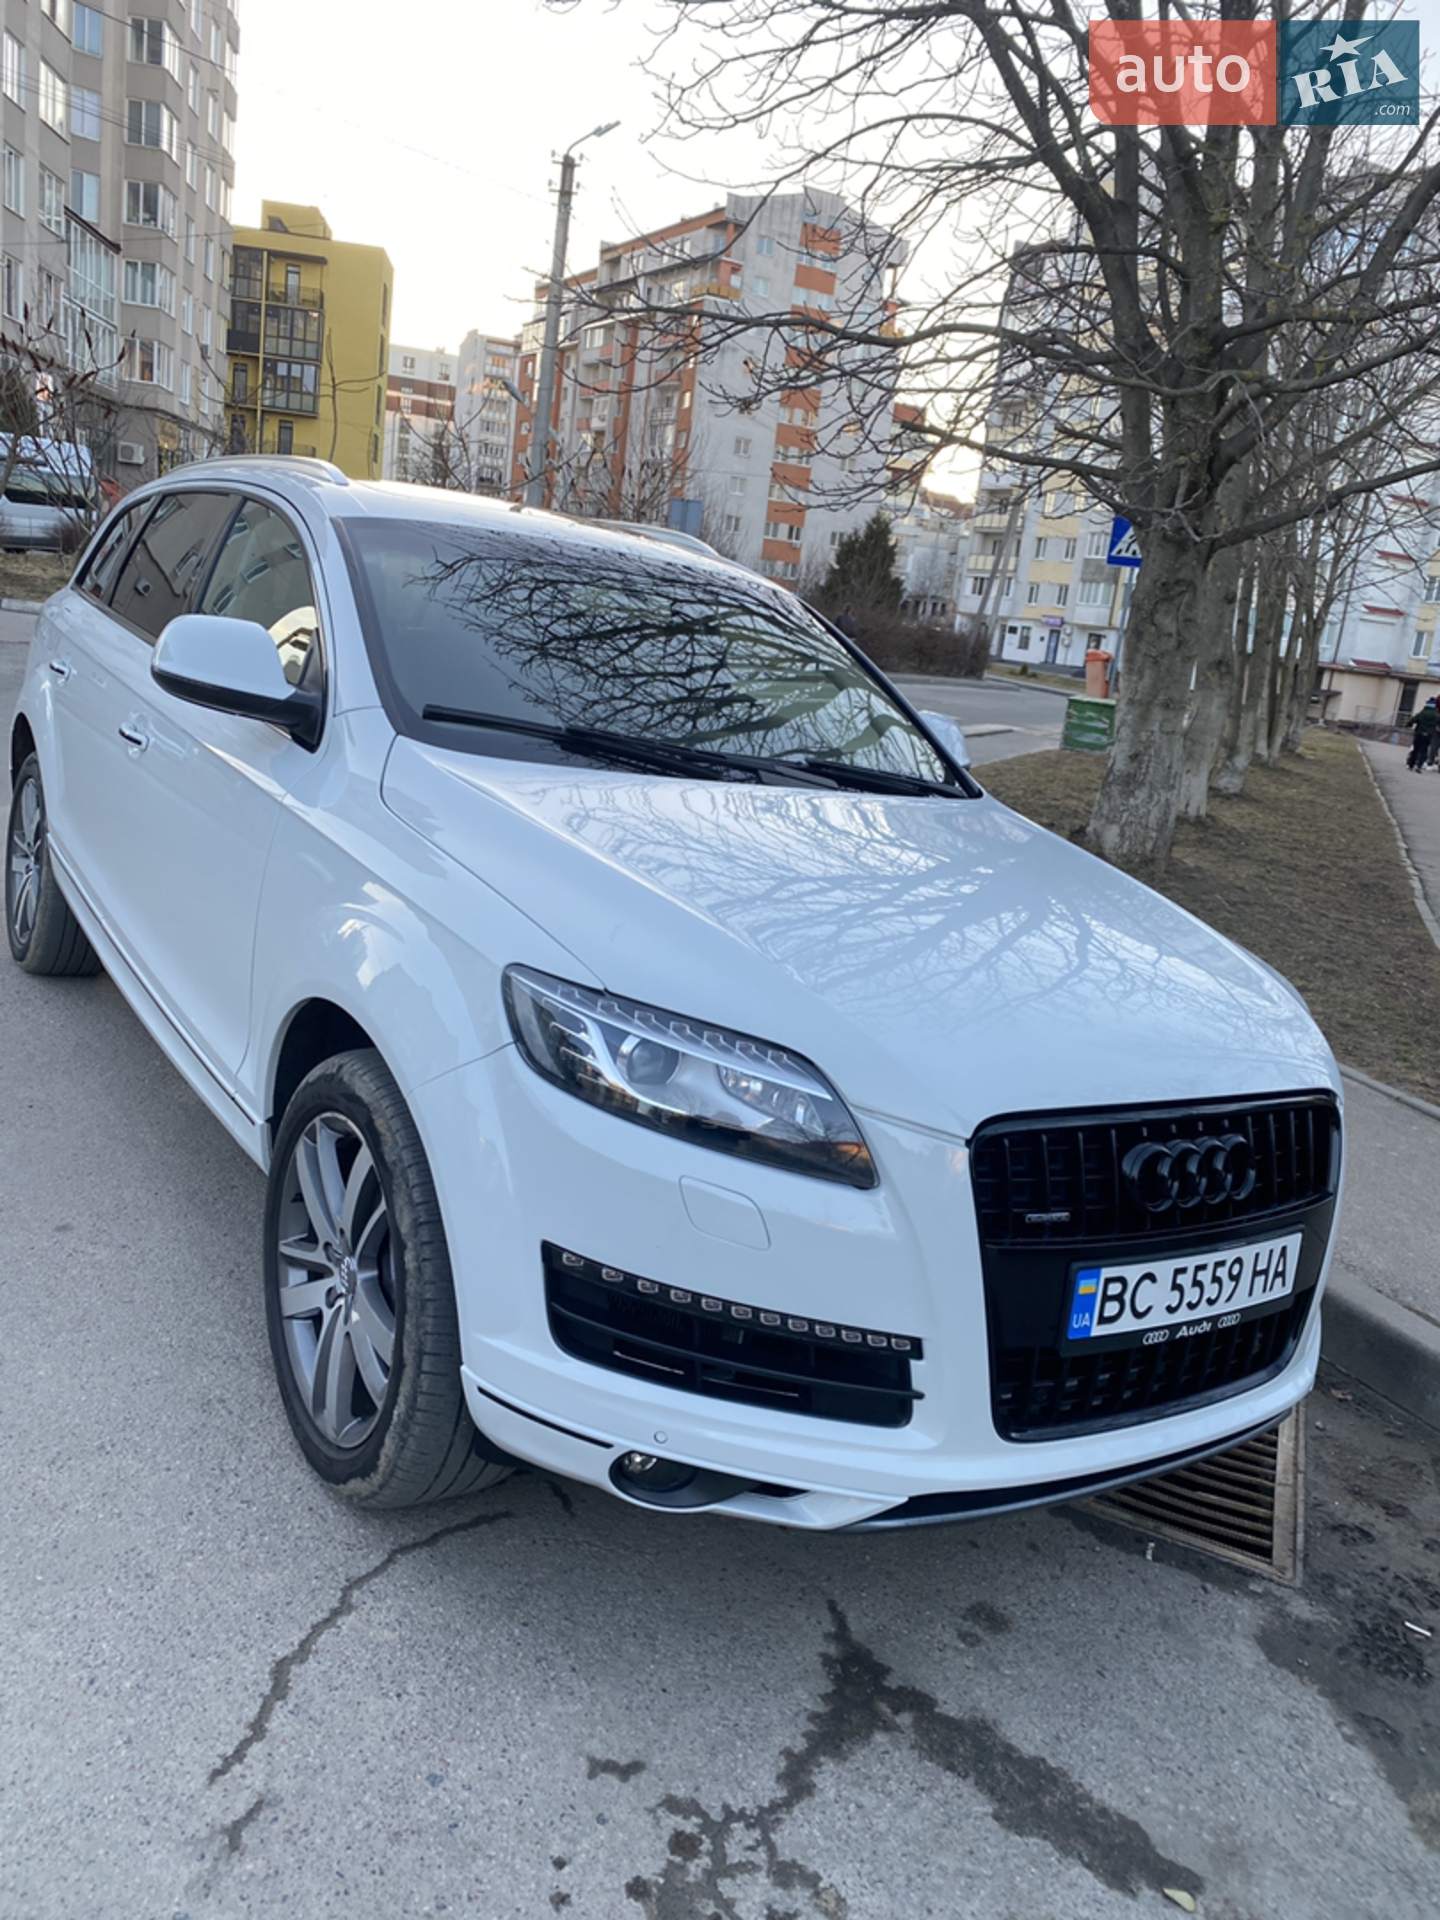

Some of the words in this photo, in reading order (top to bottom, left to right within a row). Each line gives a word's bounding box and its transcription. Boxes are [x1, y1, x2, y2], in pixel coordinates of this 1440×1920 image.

[1096, 1272, 1158, 1325] BC
[1165, 1256, 1244, 1315] 5559
[1248, 1245, 1288, 1298] HA
[1073, 1312, 1091, 1329] UA
[1176, 1320, 1212, 1339] Audi
